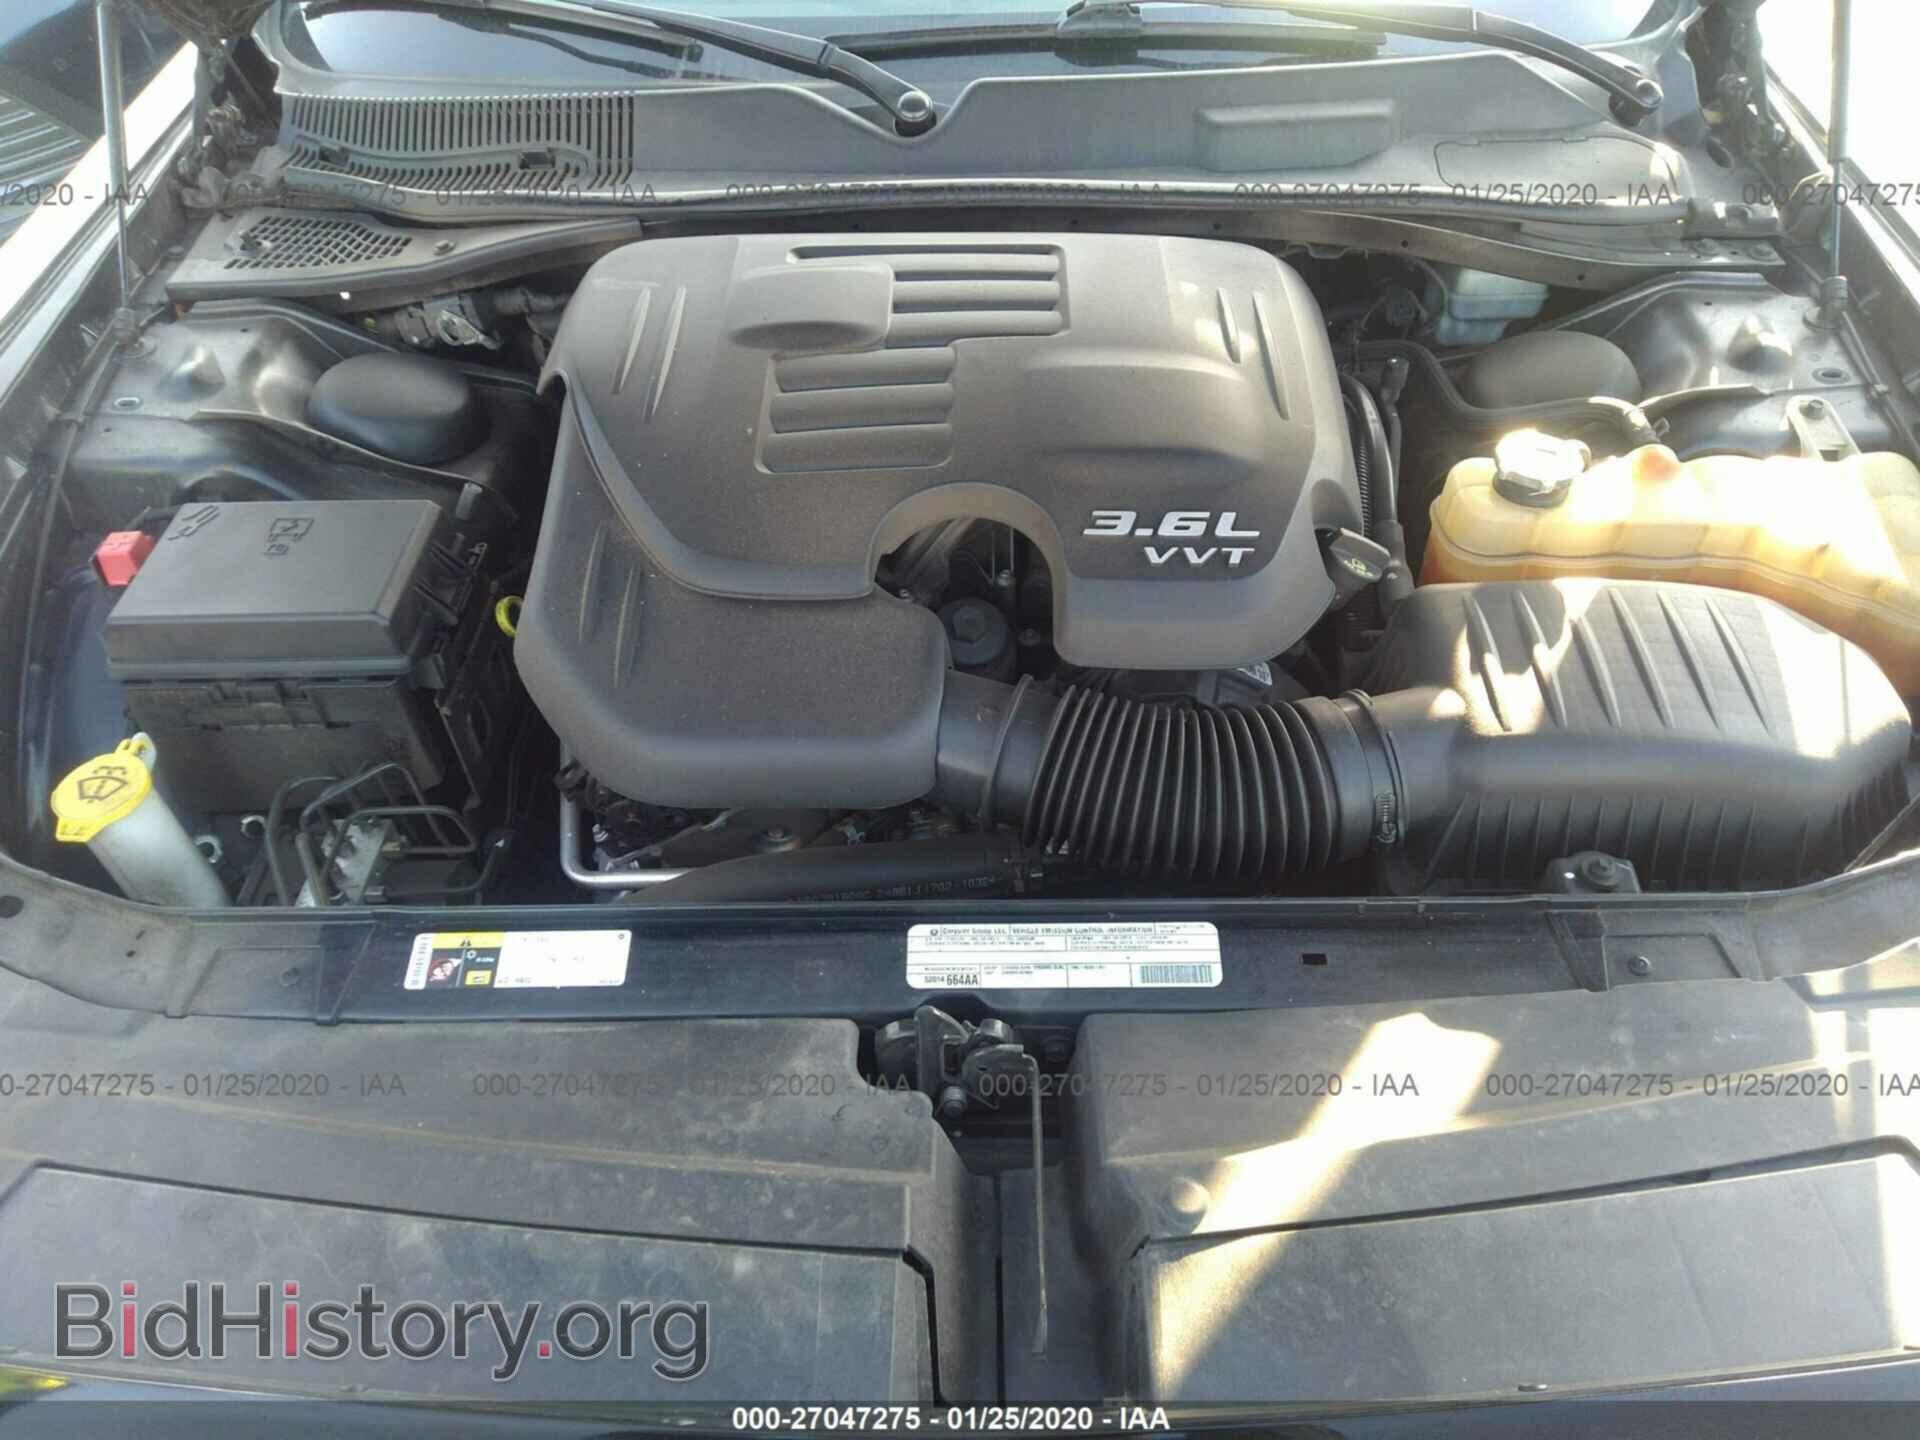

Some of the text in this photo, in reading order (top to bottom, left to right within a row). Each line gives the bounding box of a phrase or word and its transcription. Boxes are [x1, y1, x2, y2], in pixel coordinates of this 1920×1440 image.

[1083, 511, 1260, 537] 3.6L
[1143, 547, 1255, 566] VVT
[946, 974, 979, 986] 664AA
